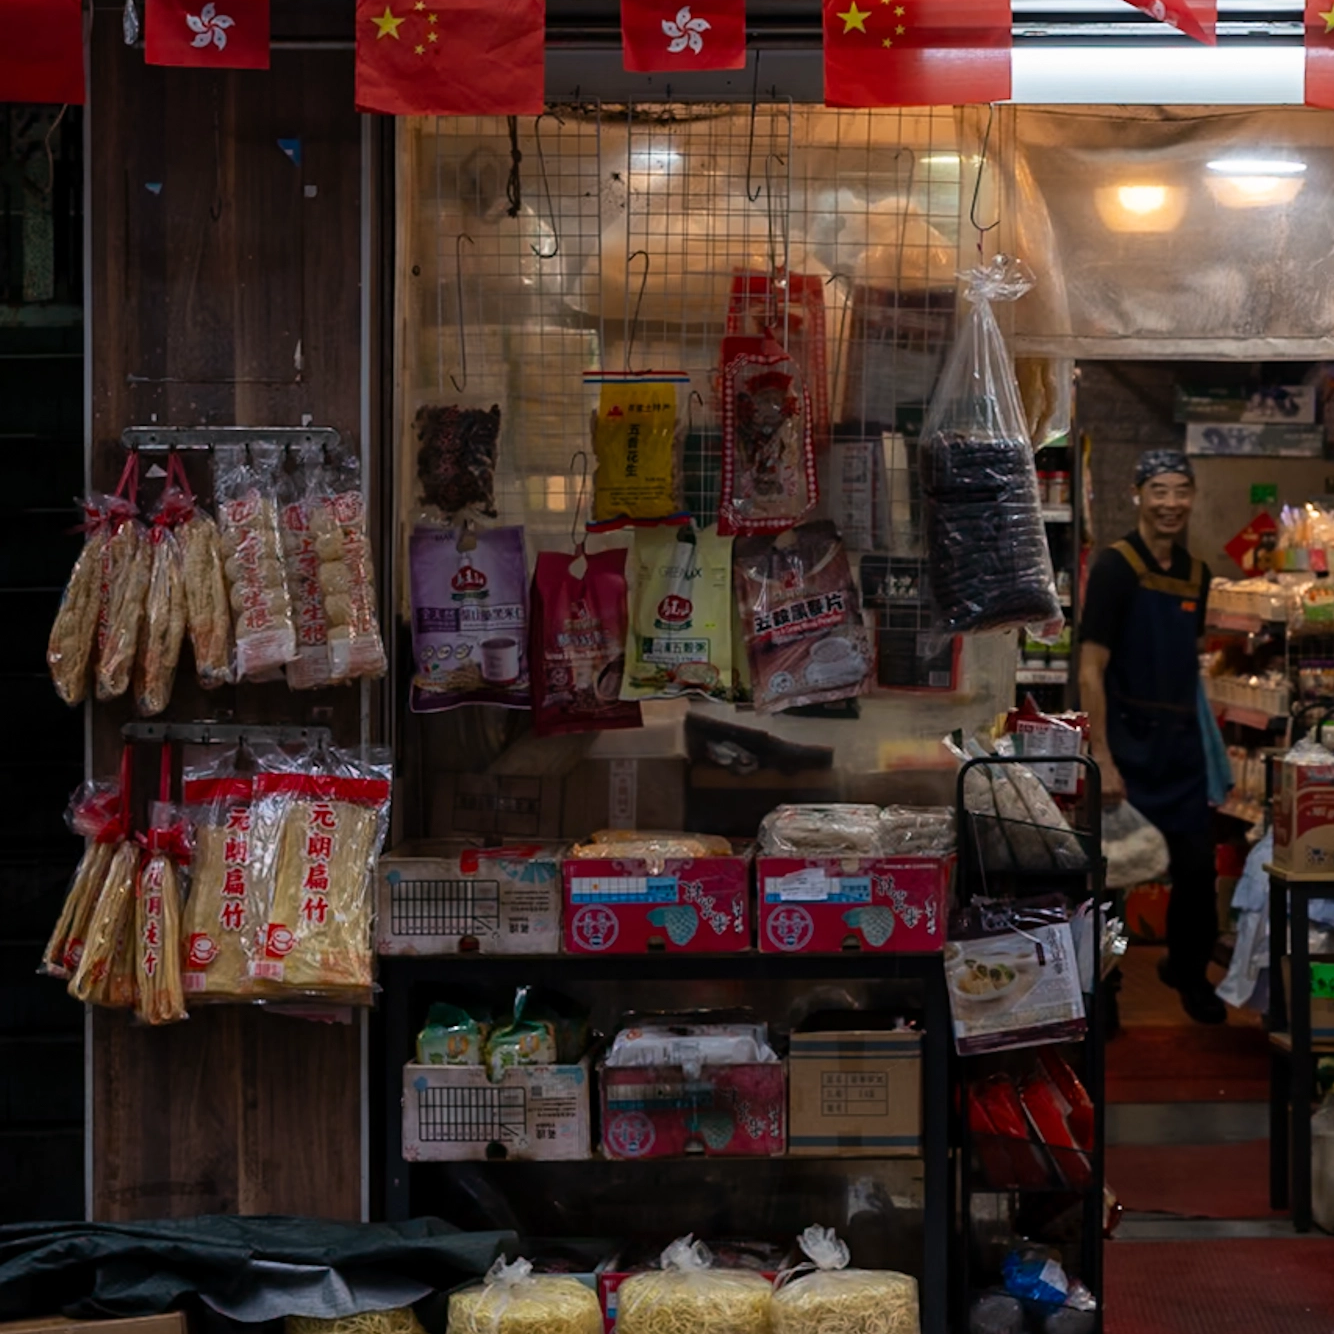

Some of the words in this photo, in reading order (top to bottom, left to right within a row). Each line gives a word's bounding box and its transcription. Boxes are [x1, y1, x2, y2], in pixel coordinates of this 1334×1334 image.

[221, 807, 250, 929] 元朗扁竹
[302, 803, 336, 924] 元朗扁竹
